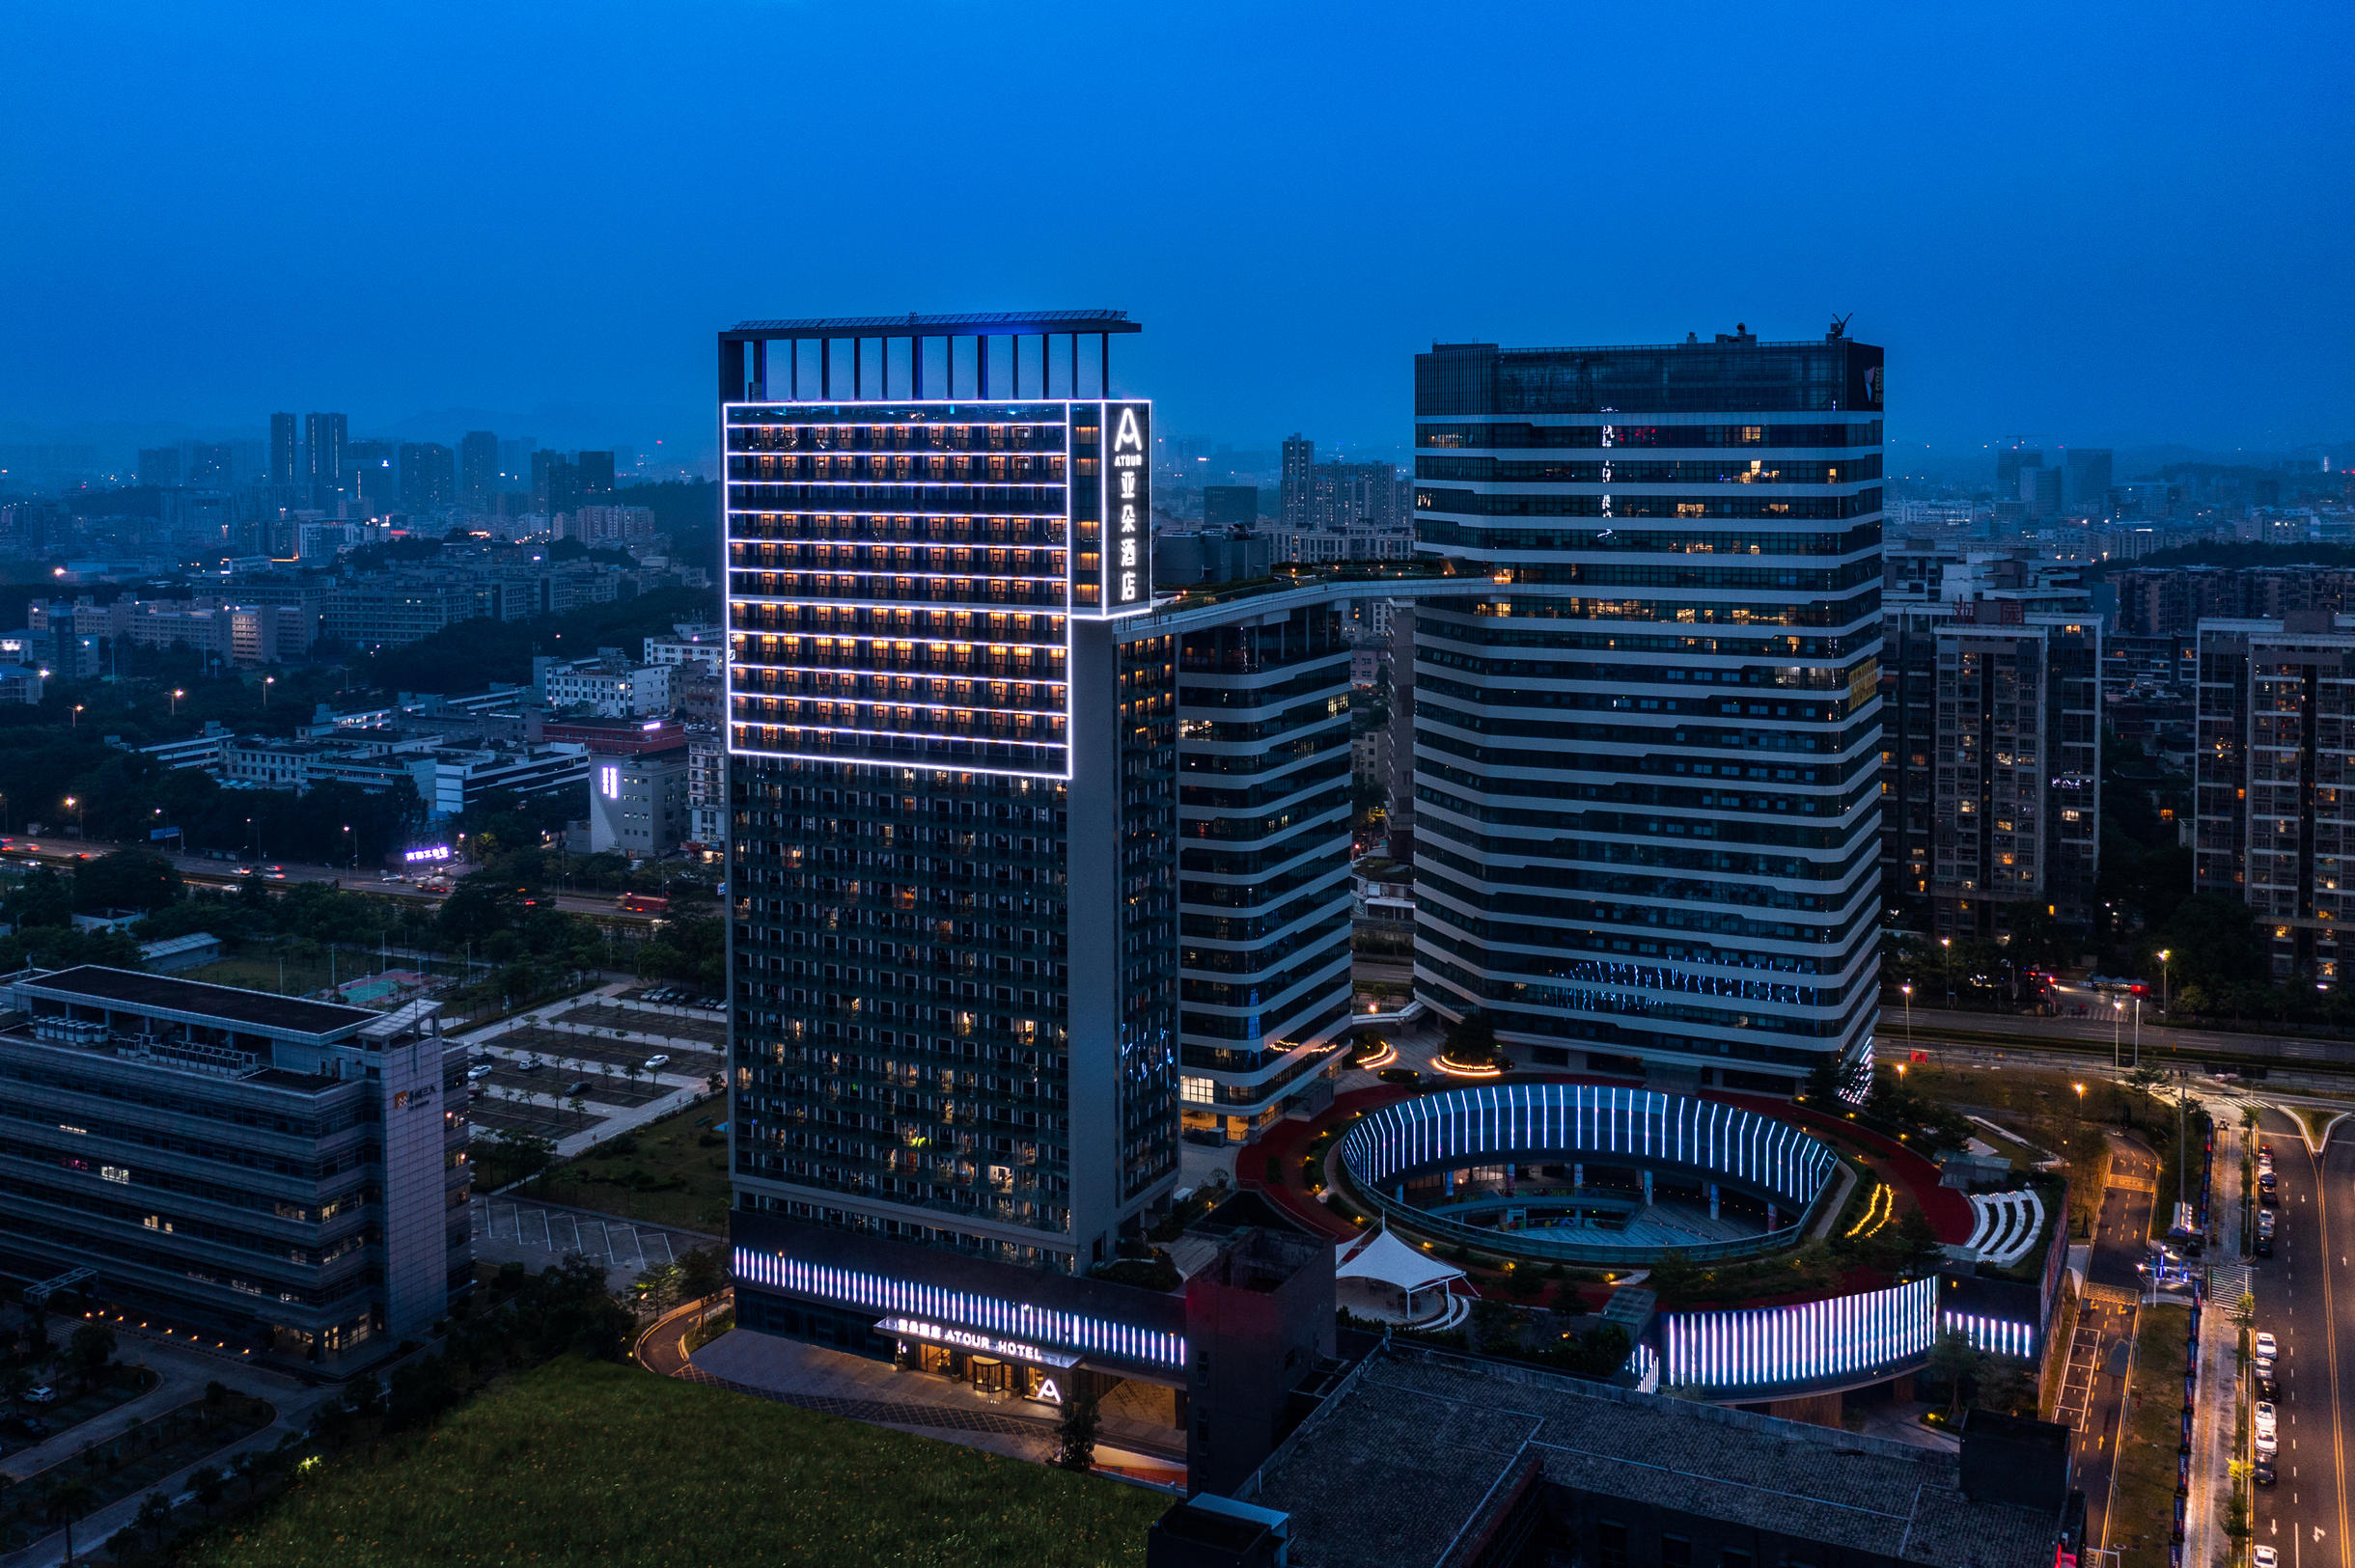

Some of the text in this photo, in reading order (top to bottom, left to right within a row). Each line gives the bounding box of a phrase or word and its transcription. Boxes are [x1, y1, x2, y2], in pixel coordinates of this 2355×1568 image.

[1114, 454, 1143, 467] ATOUR
[1121, 471, 1136, 602] 亚朵酒店
[944, 1330, 990, 1350] ATOUR
[998, 1340, 1042, 1361] HOTEL
